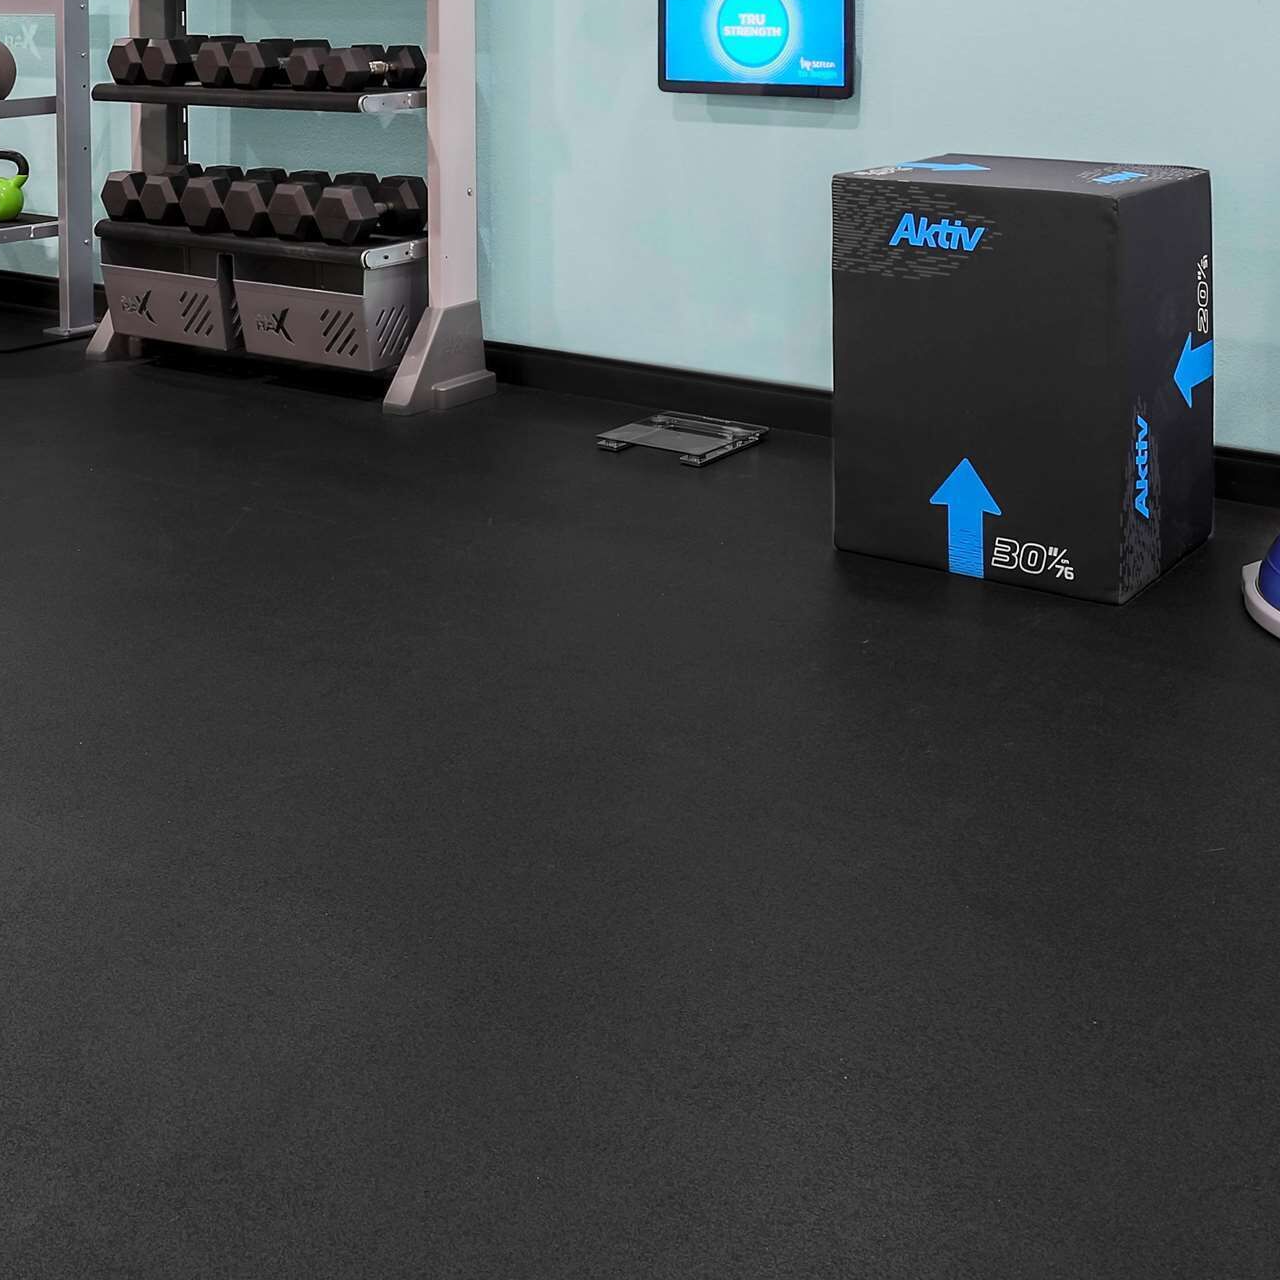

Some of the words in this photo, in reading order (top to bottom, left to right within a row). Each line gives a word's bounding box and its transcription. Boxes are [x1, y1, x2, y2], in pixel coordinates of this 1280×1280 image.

[723, 26, 782, 38] STRENGTH
[738, 13, 767, 26] TRU
[889, 212, 985, 252] Aktiv
[1134, 415, 1150, 520] Aktiv
